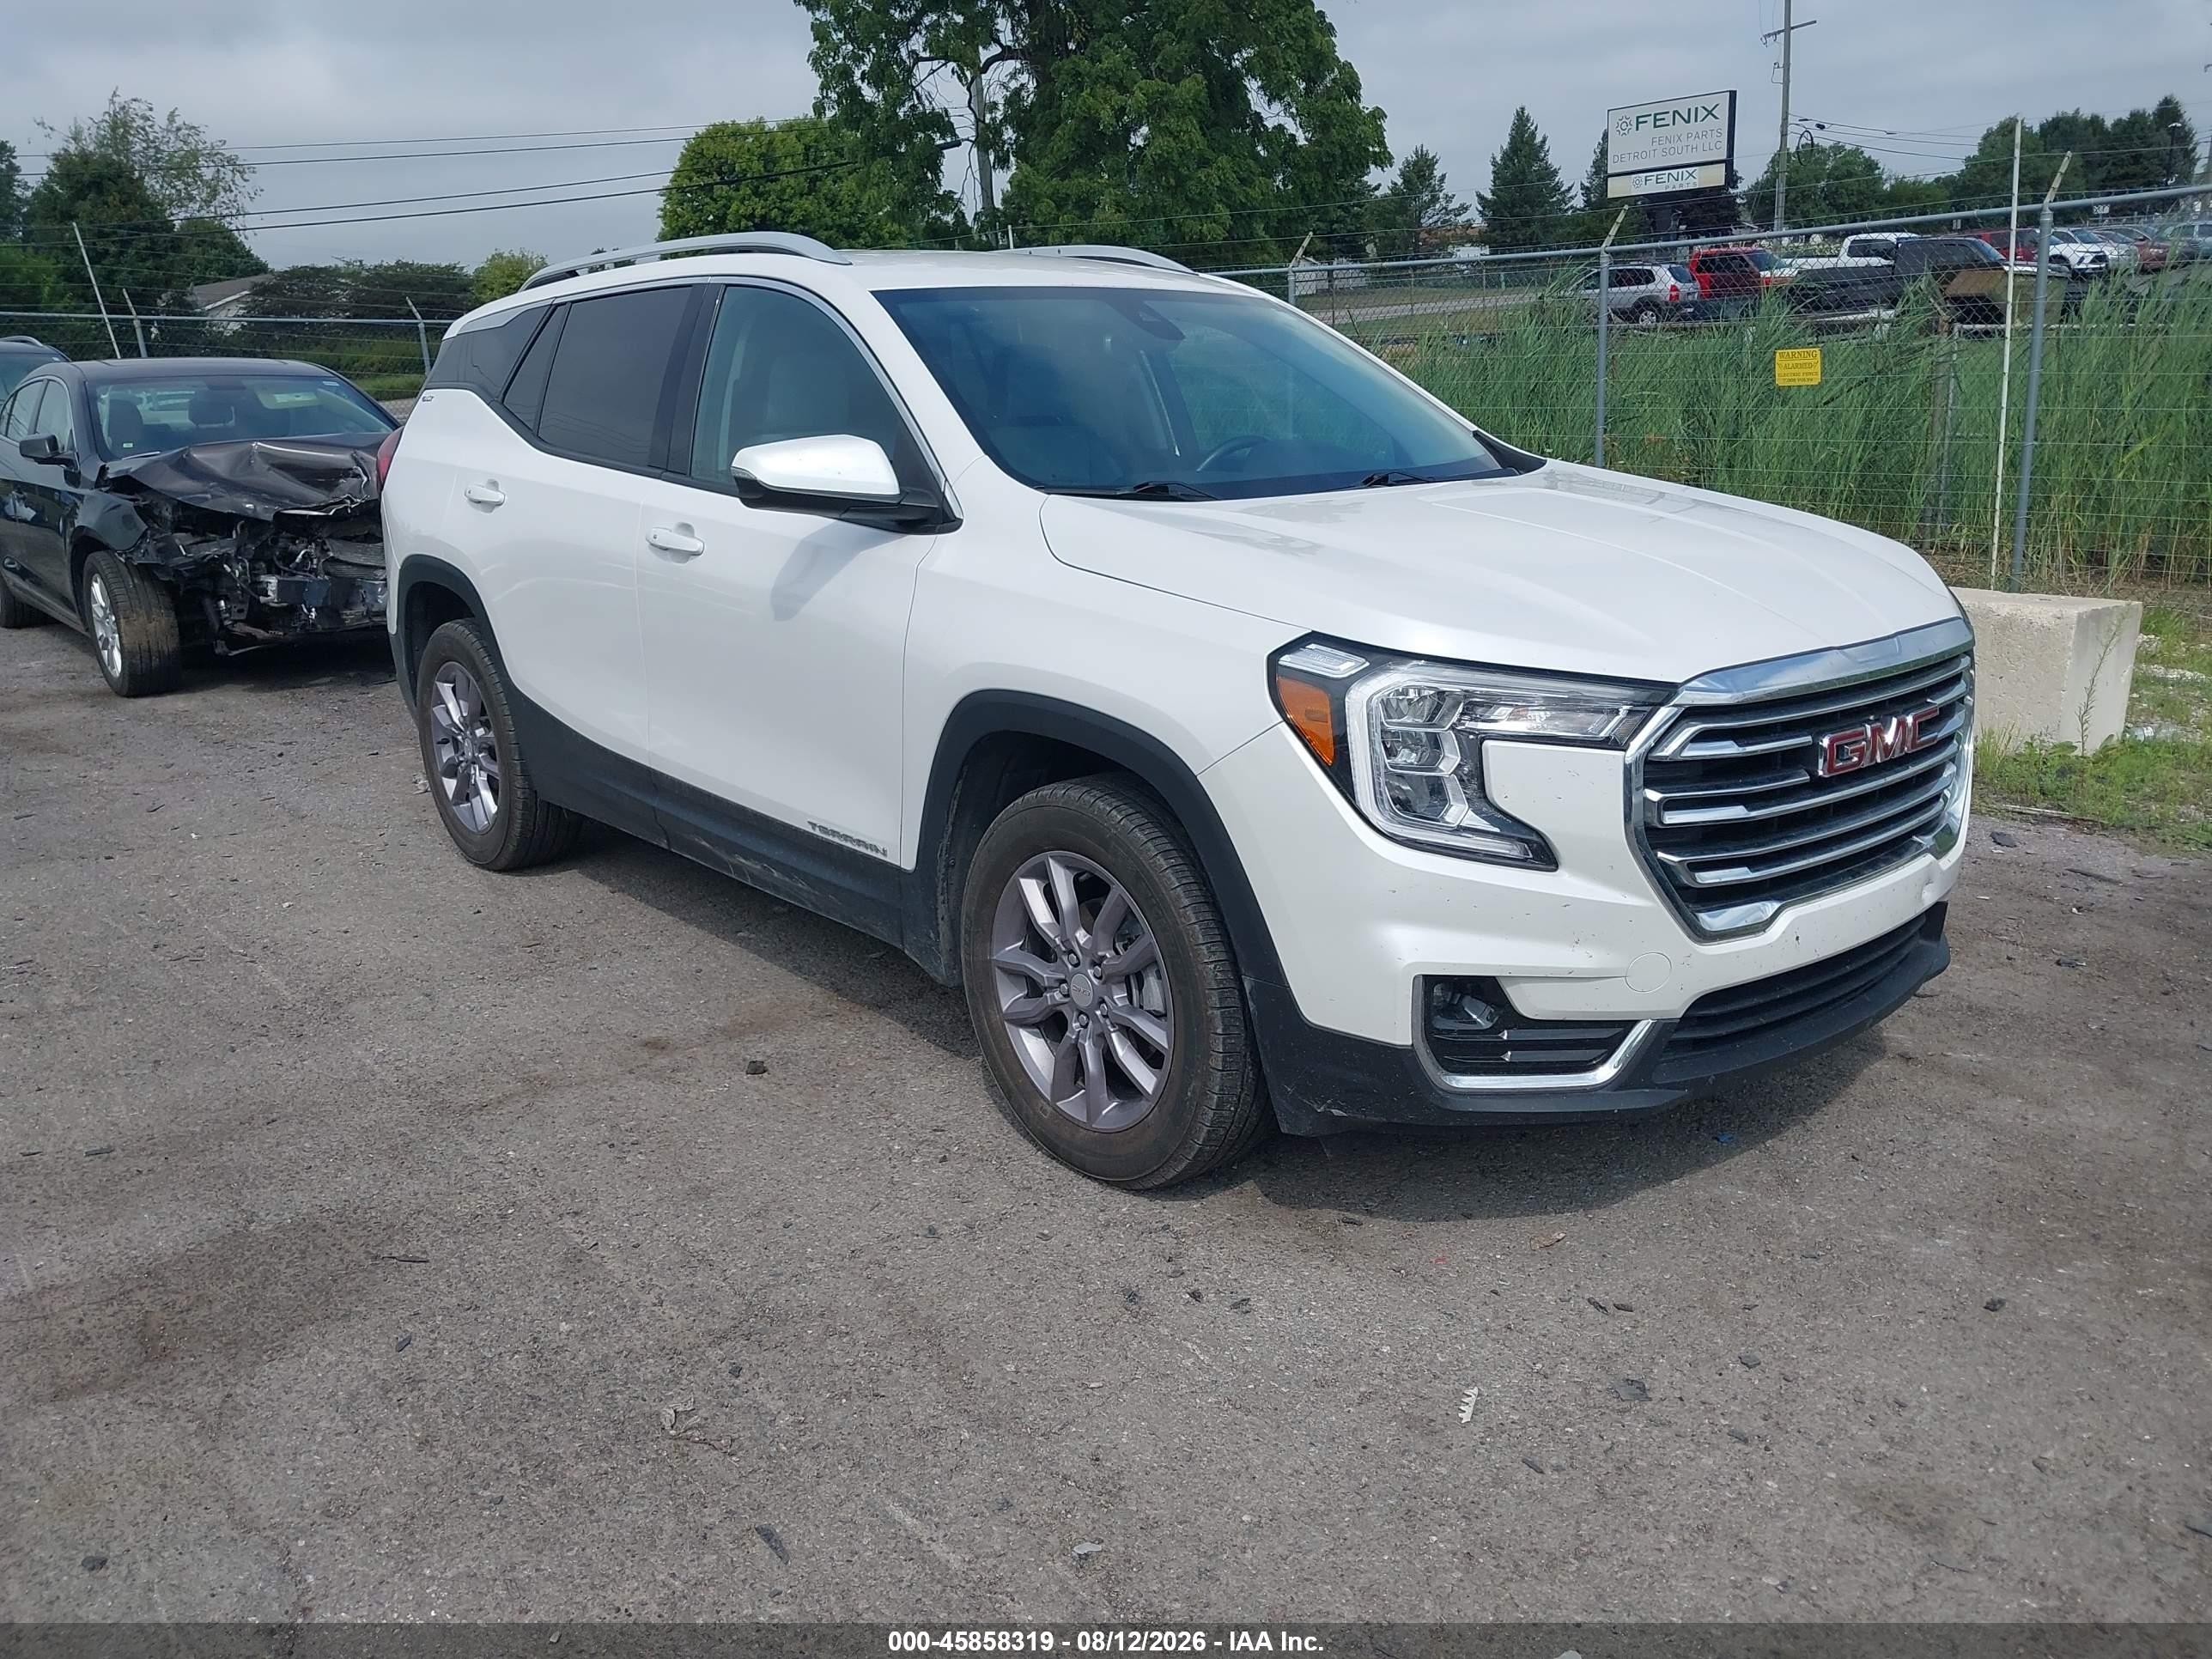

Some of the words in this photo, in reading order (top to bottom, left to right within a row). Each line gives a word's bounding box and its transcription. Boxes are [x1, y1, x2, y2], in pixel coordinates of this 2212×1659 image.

[1635, 103, 1721, 131] FENIX
[1651, 135, 1683, 147] FENIX
[1686, 128, 1723, 140] PARTS
[1613, 149, 1658, 164] DETROIT
[1662, 143, 1698, 157] SOUTH
[1702, 140, 1723, 152] LLC
[1644, 168, 1698, 186] FENIX
[1664, 181, 1698, 191] PARTS
[1778, 350, 1818, 359] WARNING
[1818, 707, 1939, 777] GMC
